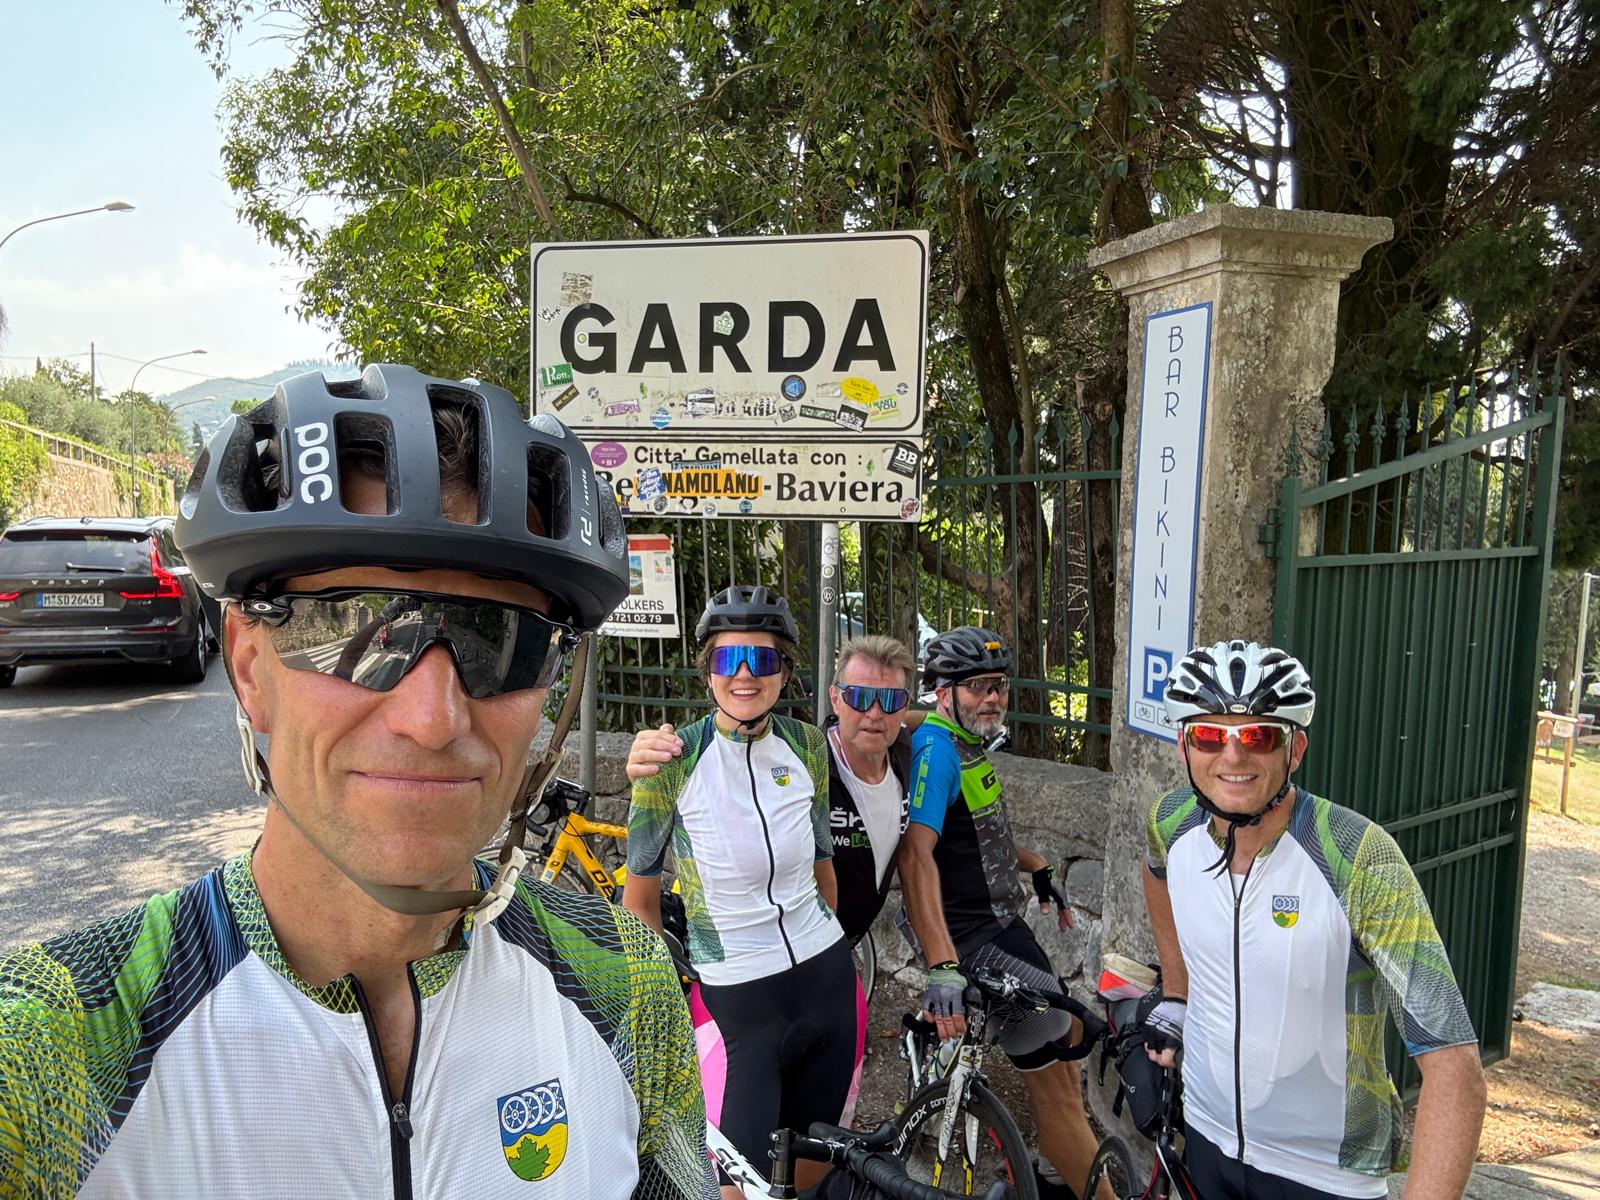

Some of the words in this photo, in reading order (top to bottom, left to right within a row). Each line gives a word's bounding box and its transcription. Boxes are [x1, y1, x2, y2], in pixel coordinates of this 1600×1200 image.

[560, 298, 897, 375] GARDA
[1164, 325, 1184, 418] BAR
[294, 422, 333, 505] POC
[695, 446, 799, 466] Gemellata
[810, 452, 847, 466] con
[895, 446, 918, 465] BB
[1155, 446, 1176, 631] BIKINI
[614, 613, 631, 622] 721
[633, 613, 647, 623] 02
[648, 614, 662, 623] 79
[1147, 654, 1168, 693] P
[831, 834, 850, 847] We
